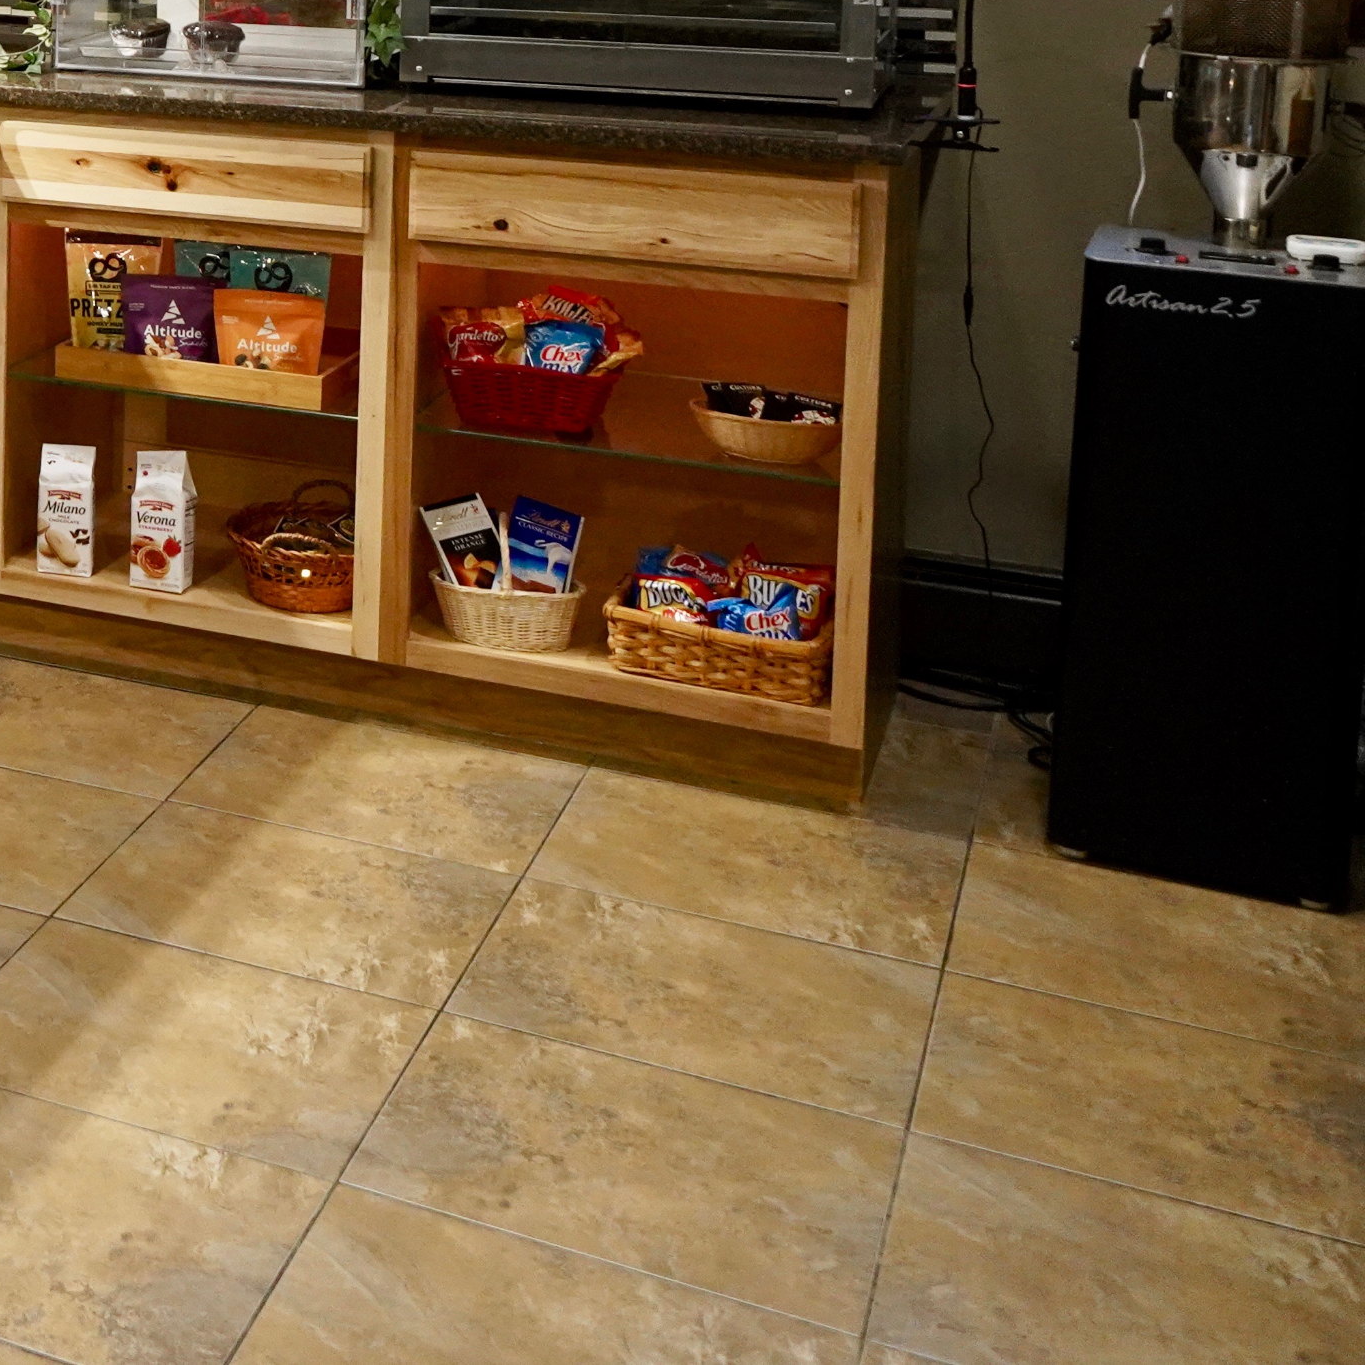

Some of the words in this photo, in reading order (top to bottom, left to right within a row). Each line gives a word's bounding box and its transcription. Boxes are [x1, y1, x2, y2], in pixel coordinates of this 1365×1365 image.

[143, 323, 203, 339] Altitude
[236, 337, 298, 353] Altitude
[540, 344, 587, 364] Chex
[42, 500, 87, 516] Milano
[136, 511, 177, 527] Verona
[451, 532, 485, 546] INTENSE
[454, 538, 487, 552] ORANGE
[745, 606, 792, 632] Chex
